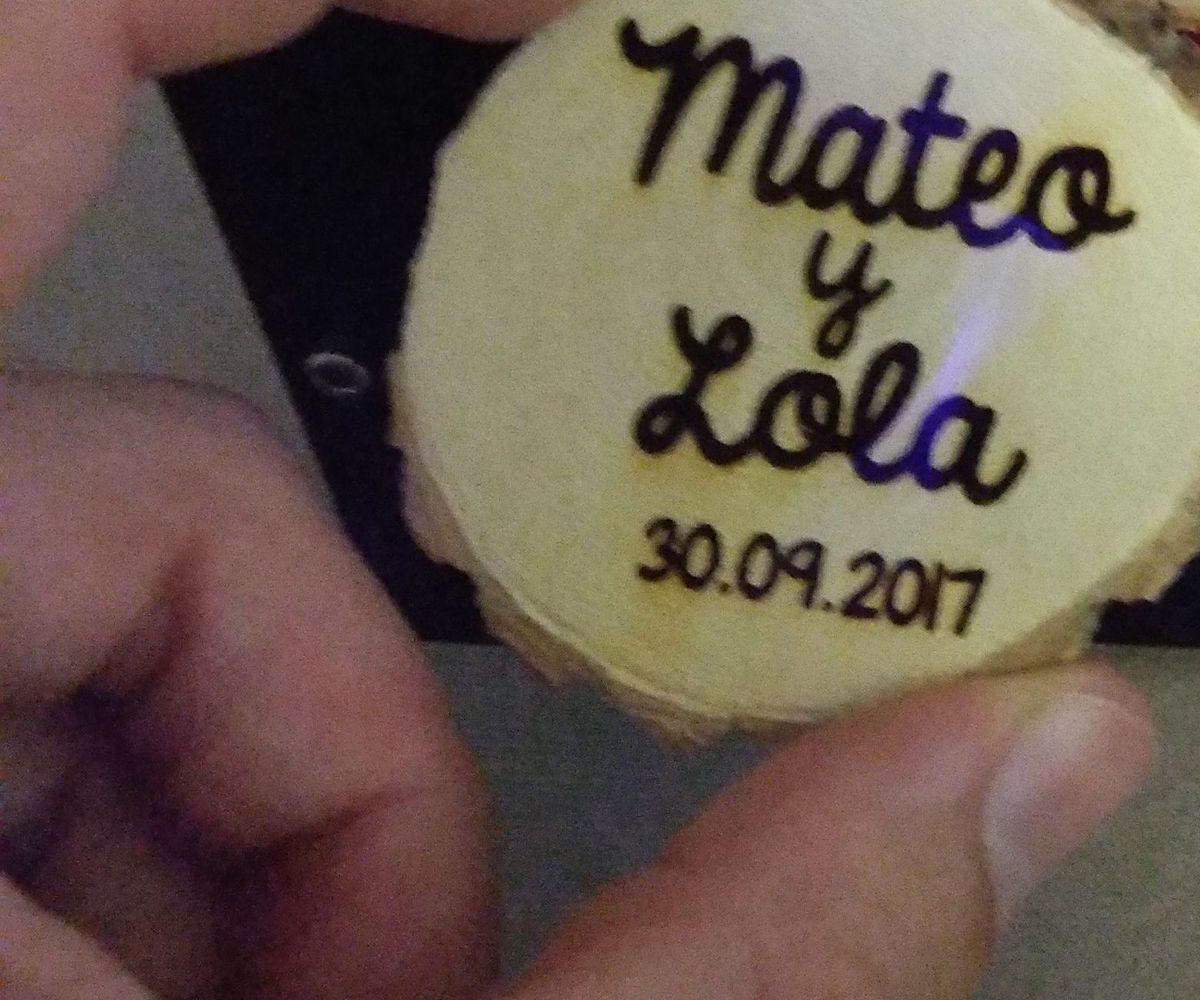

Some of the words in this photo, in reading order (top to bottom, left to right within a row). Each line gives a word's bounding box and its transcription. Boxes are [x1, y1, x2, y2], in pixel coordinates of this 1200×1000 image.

[618, 18, 1136, 251] Mateo
[806, 231, 893, 358] y
[634, 304, 1028, 505] Lola
[637, 517, 986, 636] 30.09.2017
